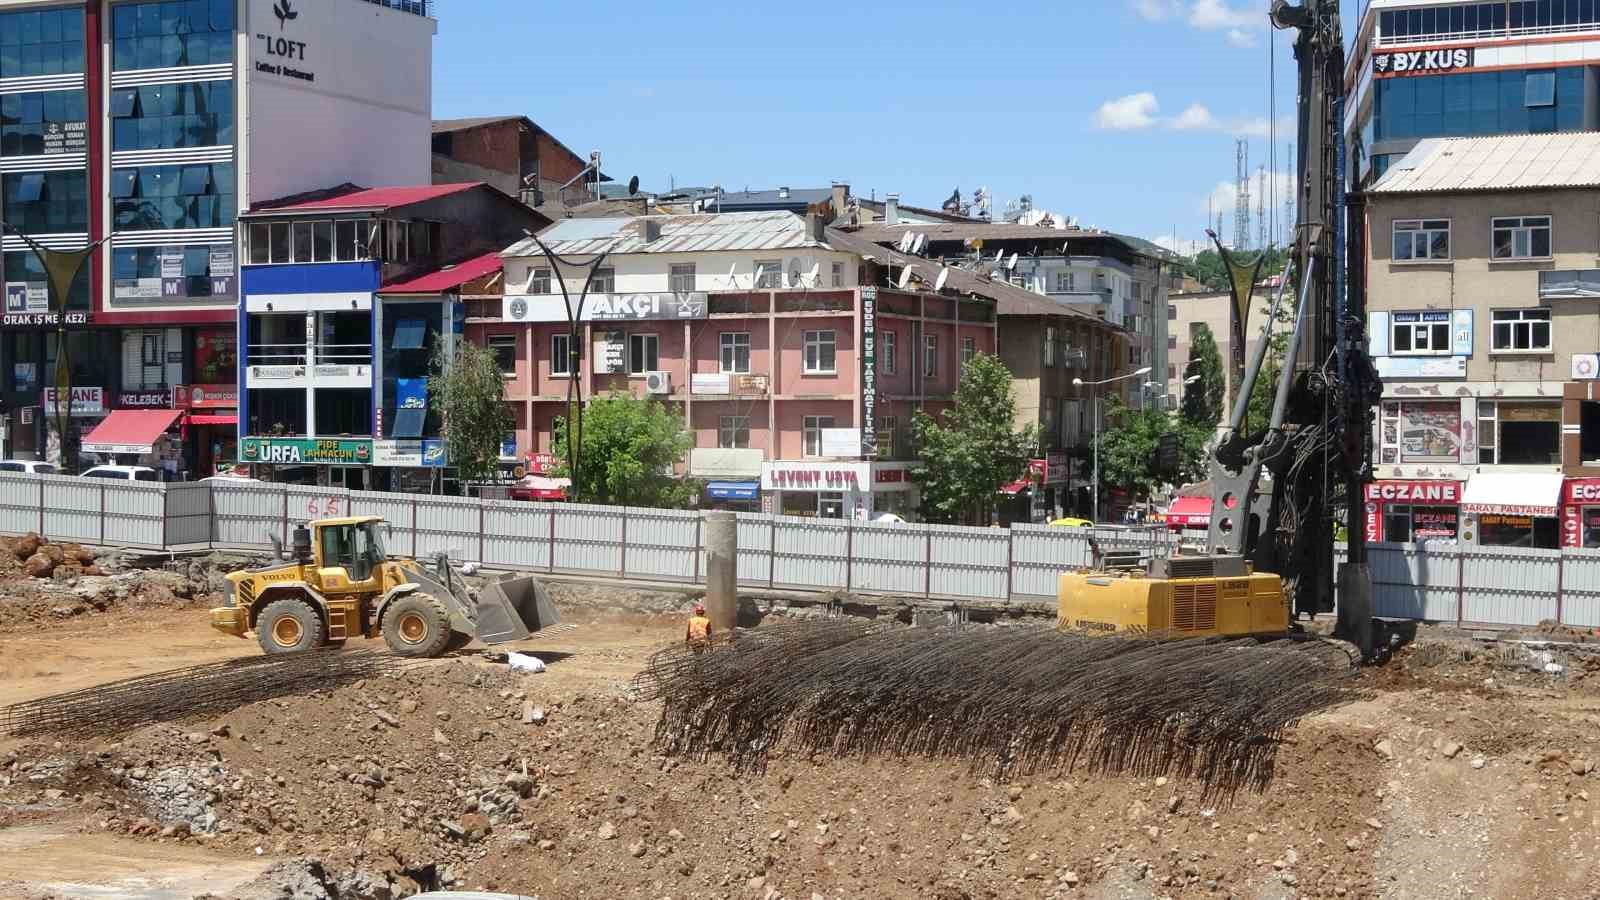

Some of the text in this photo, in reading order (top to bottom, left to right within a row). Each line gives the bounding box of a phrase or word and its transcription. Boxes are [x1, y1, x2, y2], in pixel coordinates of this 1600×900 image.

[267, 36, 306, 60] LOFT
[4, 314, 31, 325] ORAK
[1368, 484, 1456, 501] ECZANE
[262, 573, 296, 581] VOLVO
